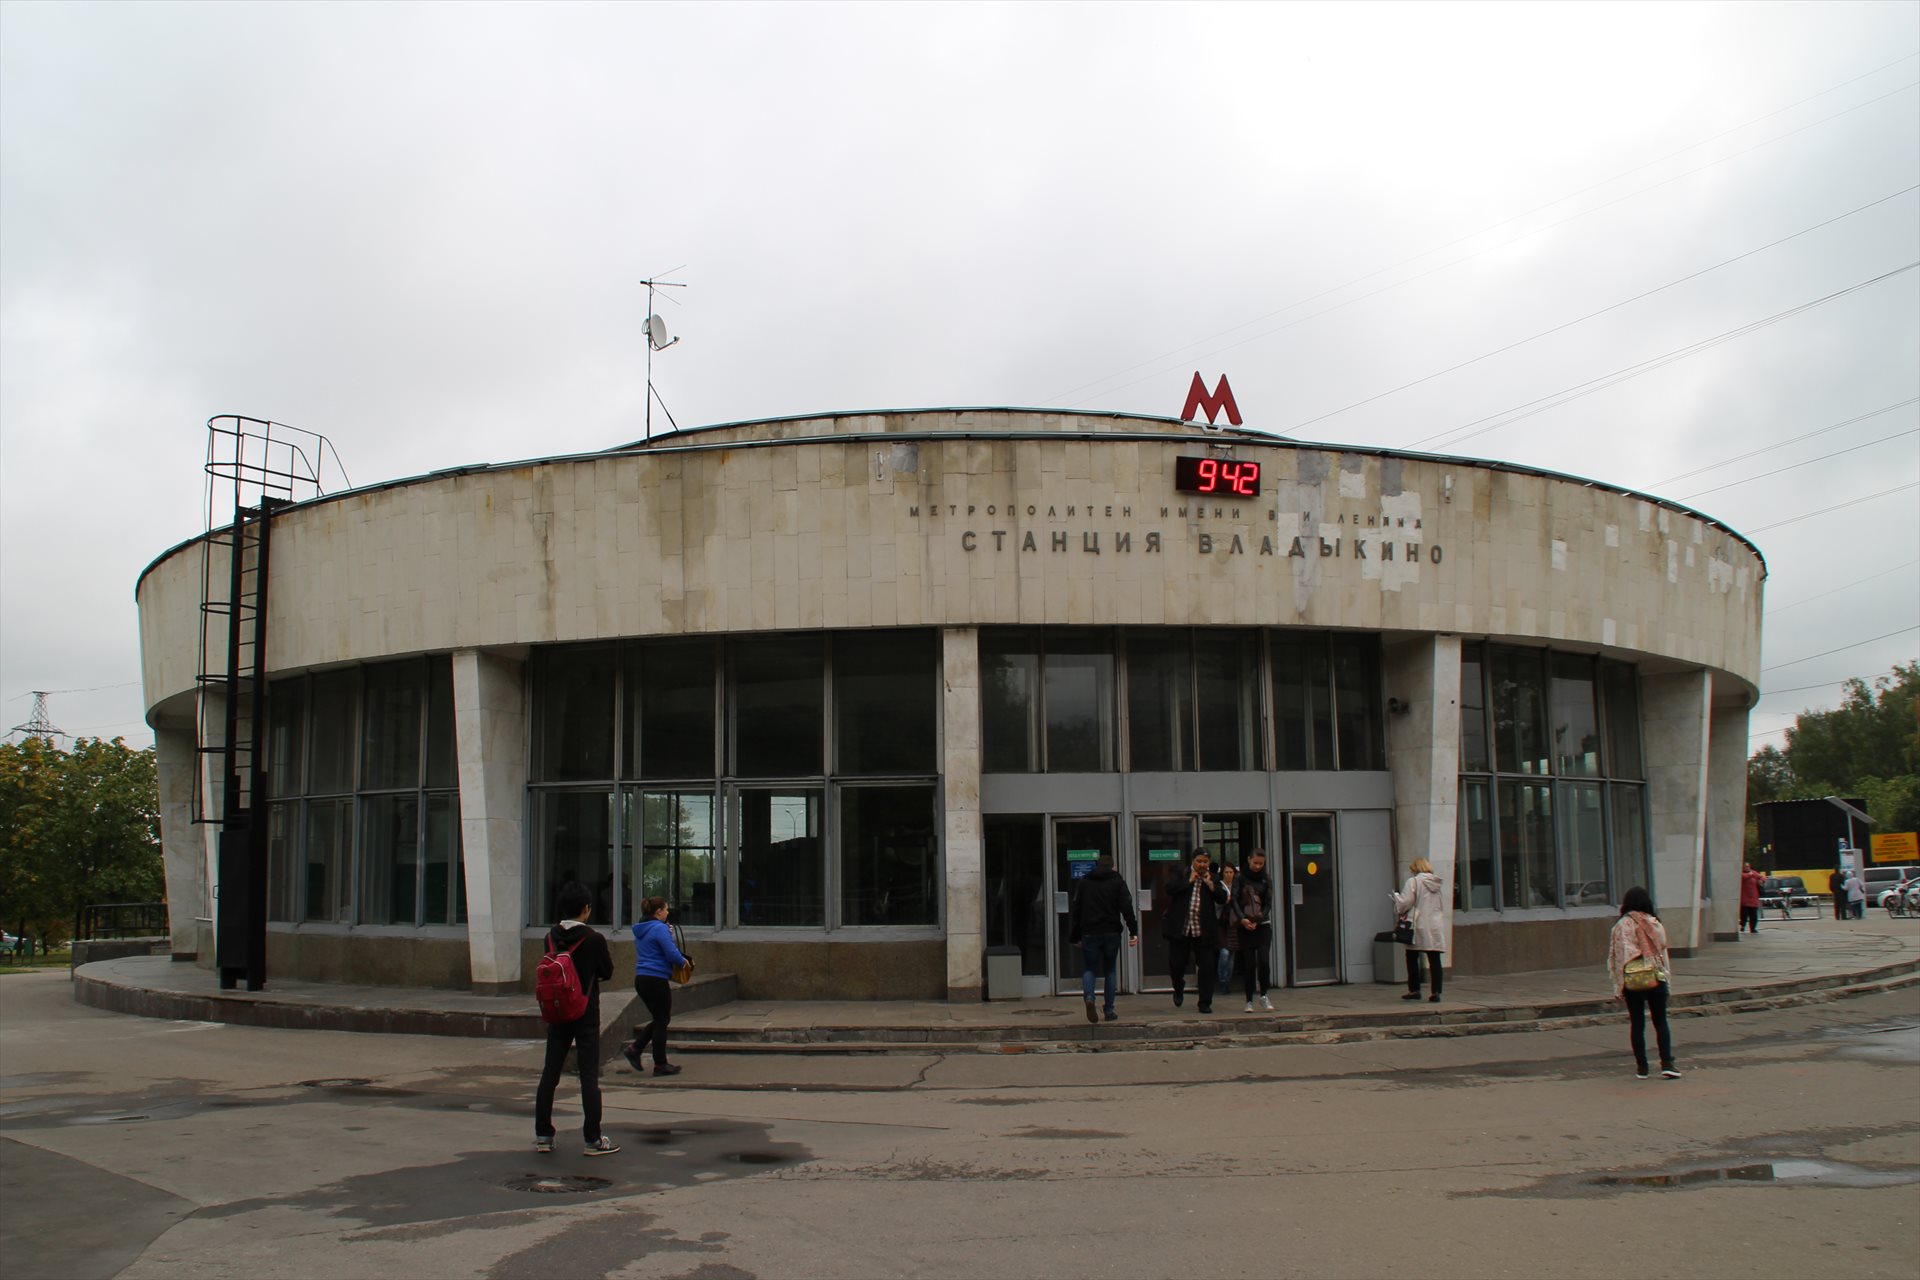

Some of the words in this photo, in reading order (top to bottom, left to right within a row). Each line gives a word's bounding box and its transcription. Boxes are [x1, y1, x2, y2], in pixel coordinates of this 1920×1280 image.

[1180, 371, 1243, 425] М
[910, 504, 1131, 518] МЕТРОПОЛИТЕН
[1160, 506, 1240, 520] ИМЕНИ
[1268, 509, 1276, 521] В
[1303, 510, 1311, 522] И
[1337, 513, 1423, 529] ЛЕНИНА
[961, 530, 1162, 555] СТАНЦИЯ
[1198, 533, 1443, 564] ВЛАДЫКИНО
